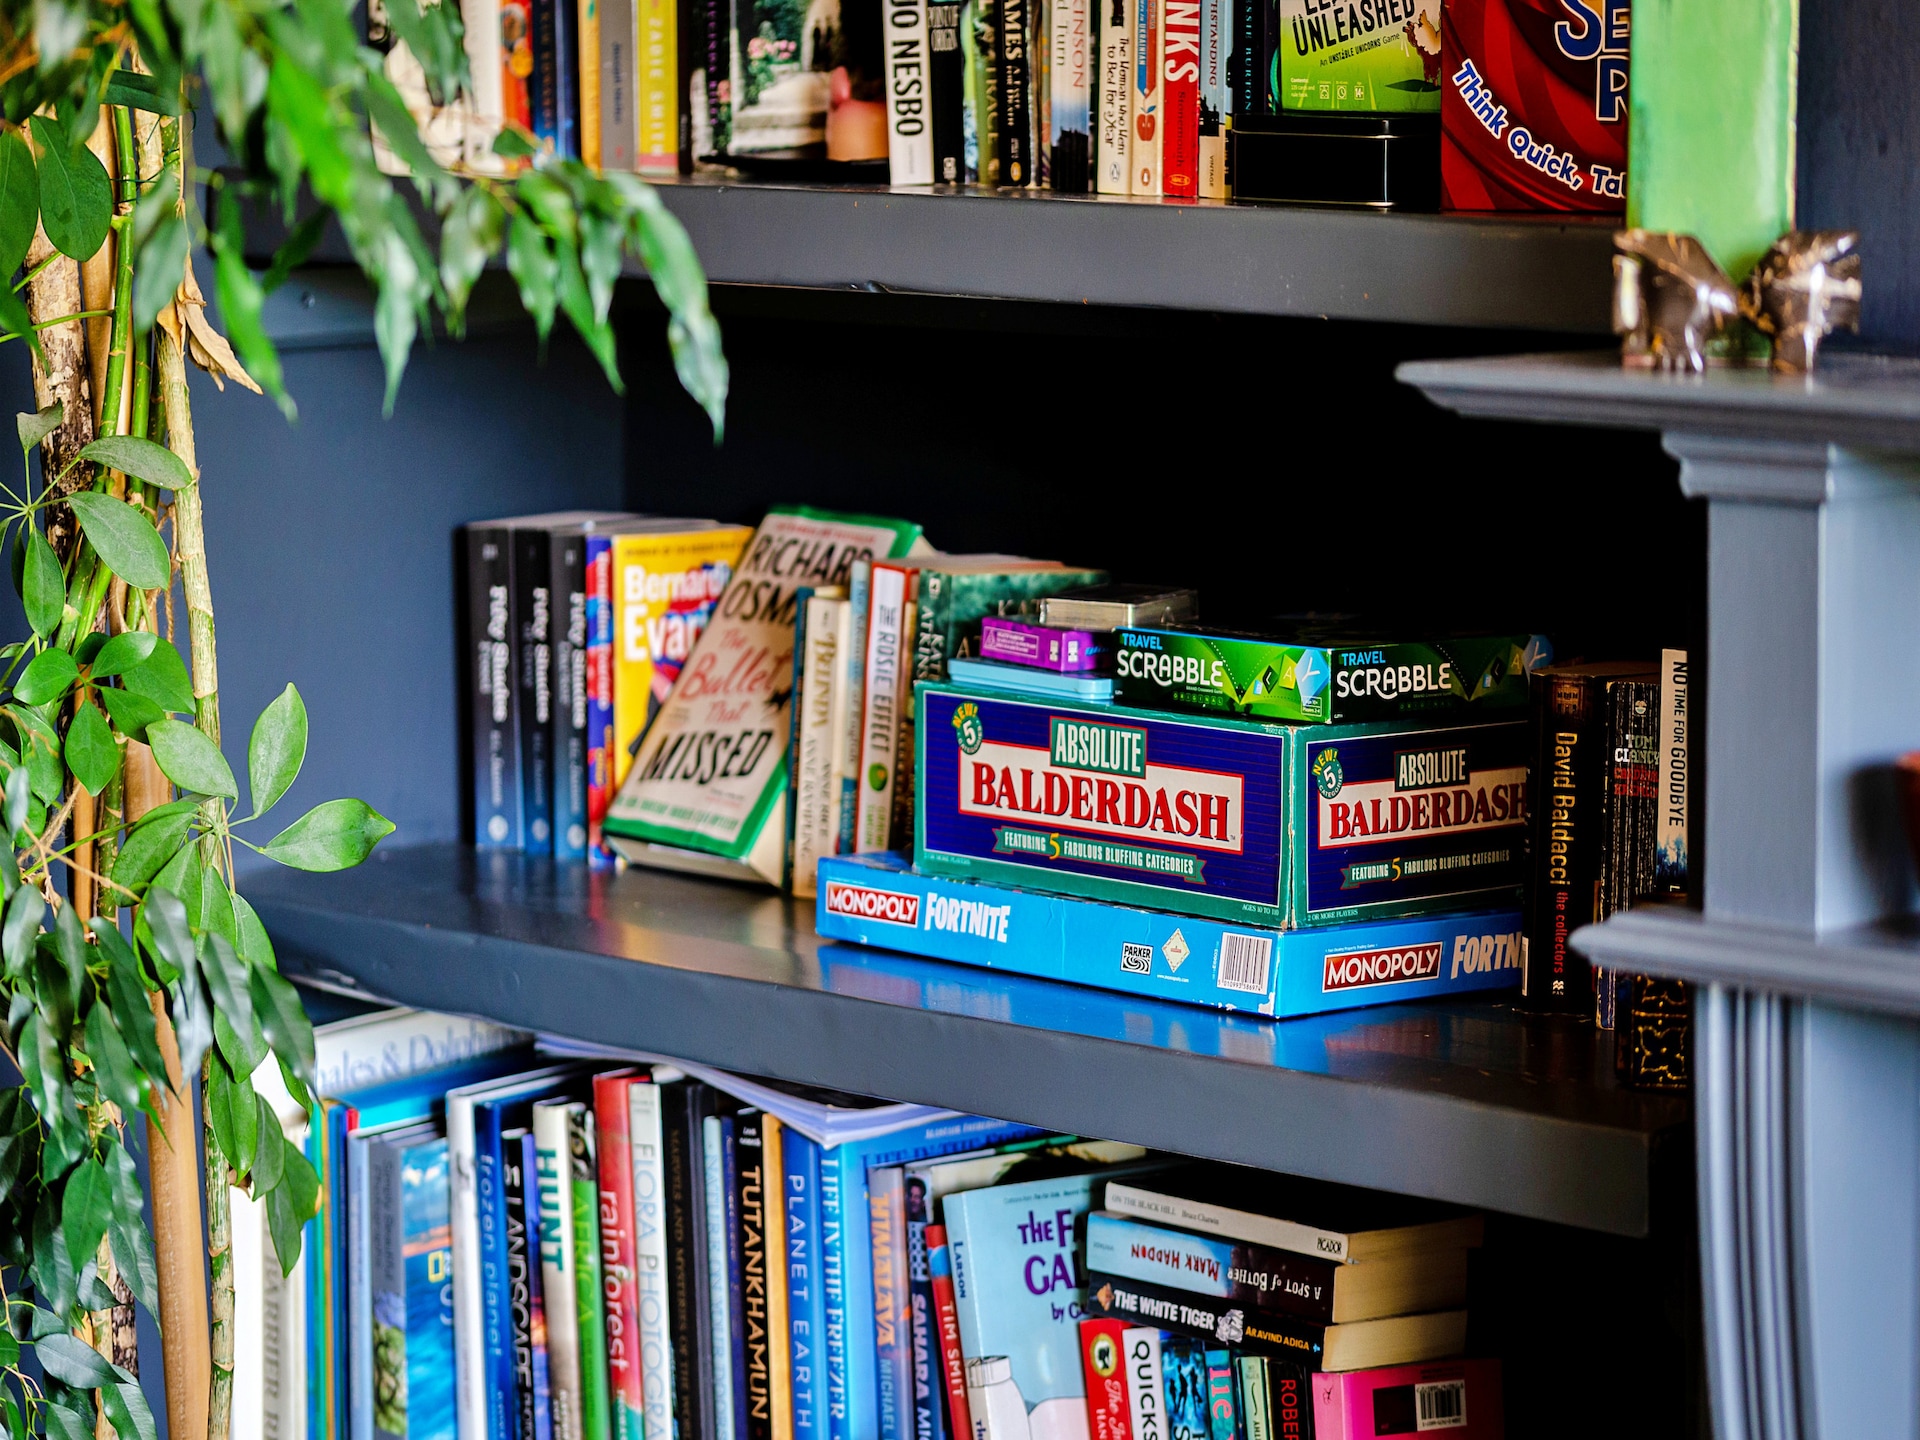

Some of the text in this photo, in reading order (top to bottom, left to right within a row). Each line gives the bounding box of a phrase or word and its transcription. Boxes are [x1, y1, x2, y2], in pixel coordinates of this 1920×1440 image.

[1056, 25, 1068, 66] Turn
[1138, 23, 1146, 66] UKRAINIAN
[1292, 0, 1416, 56] UNLEASHED
[1319, 59, 1329, 67] An
[1355, 38, 1382, 55] UNICORNS
[1382, 33, 1401, 45] Game
[892, 40, 923, 136] NESBO
[1176, 91, 1187, 167] Stonemouth
[1452, 58, 1584, 191] Think Quick,
[1122, 633, 1163, 650] TRAVEL
[1341, 650, 1386, 667] TRAVEL
[492, 641, 511, 724] Shades
[534, 643, 550, 724] Shades
[571, 648, 587, 730] Shades
[679, 646, 793, 702] Bullet
[1116, 649, 1224, 688] SCRABBLE
[1336, 662, 1452, 700] SCRABBLE
[705, 701, 751, 723] That
[870, 694, 892, 755] EFFECT
[951, 703, 979, 728] NEW!
[963, 719, 977, 745] 5
[639, 730, 775, 785] MISSED
[1055, 722, 1142, 774] ABSOLUTE
[1312, 749, 1338, 776] NEW!
[1614, 748, 1660, 765] CLANCY
[1625, 734, 1654, 749] TOM
[1669, 661, 1688, 827] NO TIME FOR GOODBYE
[1318, 769, 1344, 798] CATEGORIES
[1323, 765, 1337, 789] 5
[1398, 749, 1466, 788] ABSOLUTE
[971, 761, 1230, 842] BALDERDASH
[1328, 782, 1528, 840] BALDERDASH
[1004, 831, 1194, 875] FEATURING 5 FABULOUS BLUFFING CATEGORIES
[1351, 849, 1510, 881] FEATURING 5 FABULOUS BLUFFING CATEGORIES
[1550, 732, 1578, 974] David Baldacci the collectors
[828, 886, 1011, 944] MONOPOLY FORTNITE
[1242, 904, 1257, 913] AGES
[1263, 907, 1271, 915] TO
[1307, 908, 1358, 922] 2 OR MORE PLAYERS
[1124, 945, 1151, 959] PARKER
[1326, 948, 1439, 986] MONOPOLY
[381, 1041, 400, 1079] &
[536, 1149, 563, 1272] HUNT
[634, 1144, 657, 1240] FLORA
[1111, 1194, 1122, 1204] ON
[1123, 1196, 1137, 1207] THE
[1137, 1199, 1160, 1213] BLACK
[1160, 1205, 1176, 1216] HILL
[480, 1154, 503, 1357] frozen planet
[1130, 1243, 1180, 1270] HADDON
[1317, 1237, 1343, 1255] PICADOR
[599, 1190, 632, 1372] rainforest
[953, 1241, 966, 1299] LARSON
[1185, 1253, 1221, 1282] MARK
[1227, 1266, 1269, 1291] BOTHER
[1270, 1274, 1282, 1291] of
[506, 1197, 532, 1388] LANDSCAPE
[741, 1165, 769, 1420] TUTANKHAMUN
[788, 1174, 812, 1428] PLANET EARTH
[821, 1158, 846, 1420] LIFE IN THE FREEZER
[1284, 1281, 1310, 1299] SPOT
[1314, 1286, 1322, 1300] A
[870, 1192, 896, 1434] HIMALAYA MICHAEL
[1051, 1302, 1065, 1324] by
[1114, 1289, 1310, 1351] THE WHITE TIGER ARAVIND ADIGA
[912, 1293, 930, 1400] SAHARA
[941, 1302, 965, 1399] TIM SMIT
[1104, 1378, 1123, 1414] The
